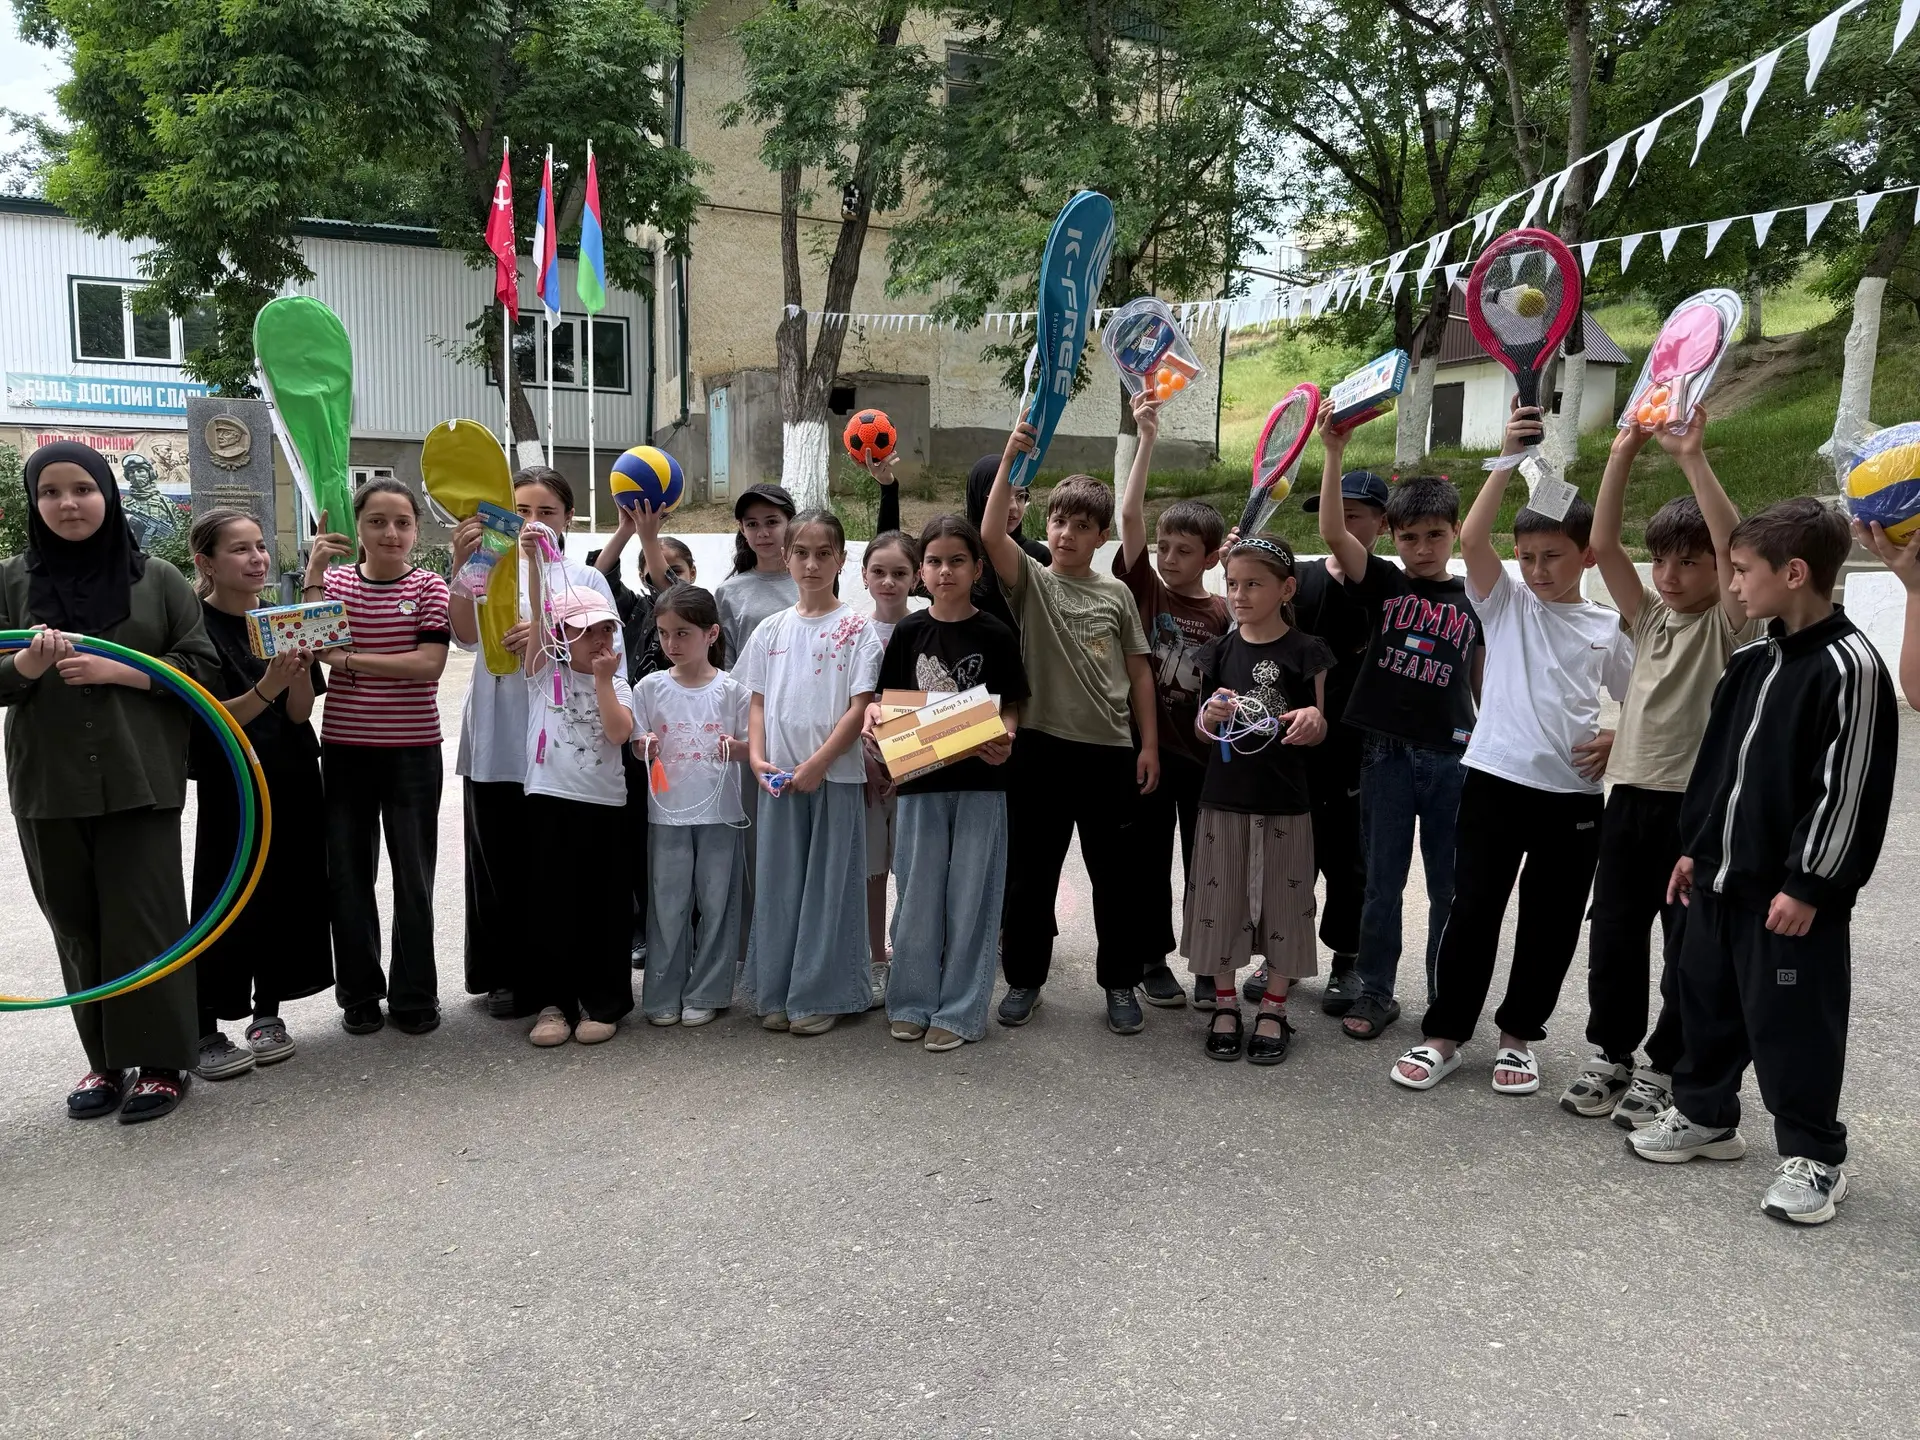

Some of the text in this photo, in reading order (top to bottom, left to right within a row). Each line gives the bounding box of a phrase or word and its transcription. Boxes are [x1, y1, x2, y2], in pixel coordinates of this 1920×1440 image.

[1053, 227, 1083, 398] K-FREE
[1393, 358, 1407, 391] ДОМИНО
[24, 379, 72, 402] БУДЬ
[76, 382, 151, 407] ДОСТОИН
[89, 435, 135, 451] ПОМНИМ
[303, 604, 343, 620] ЛОТО
[1172, 616, 1205, 628] TRUSTED
[1381, 594, 1476, 662] TOMMY
[1377, 646, 1453, 687] JEANS
[932, 704, 957, 716] Набор
